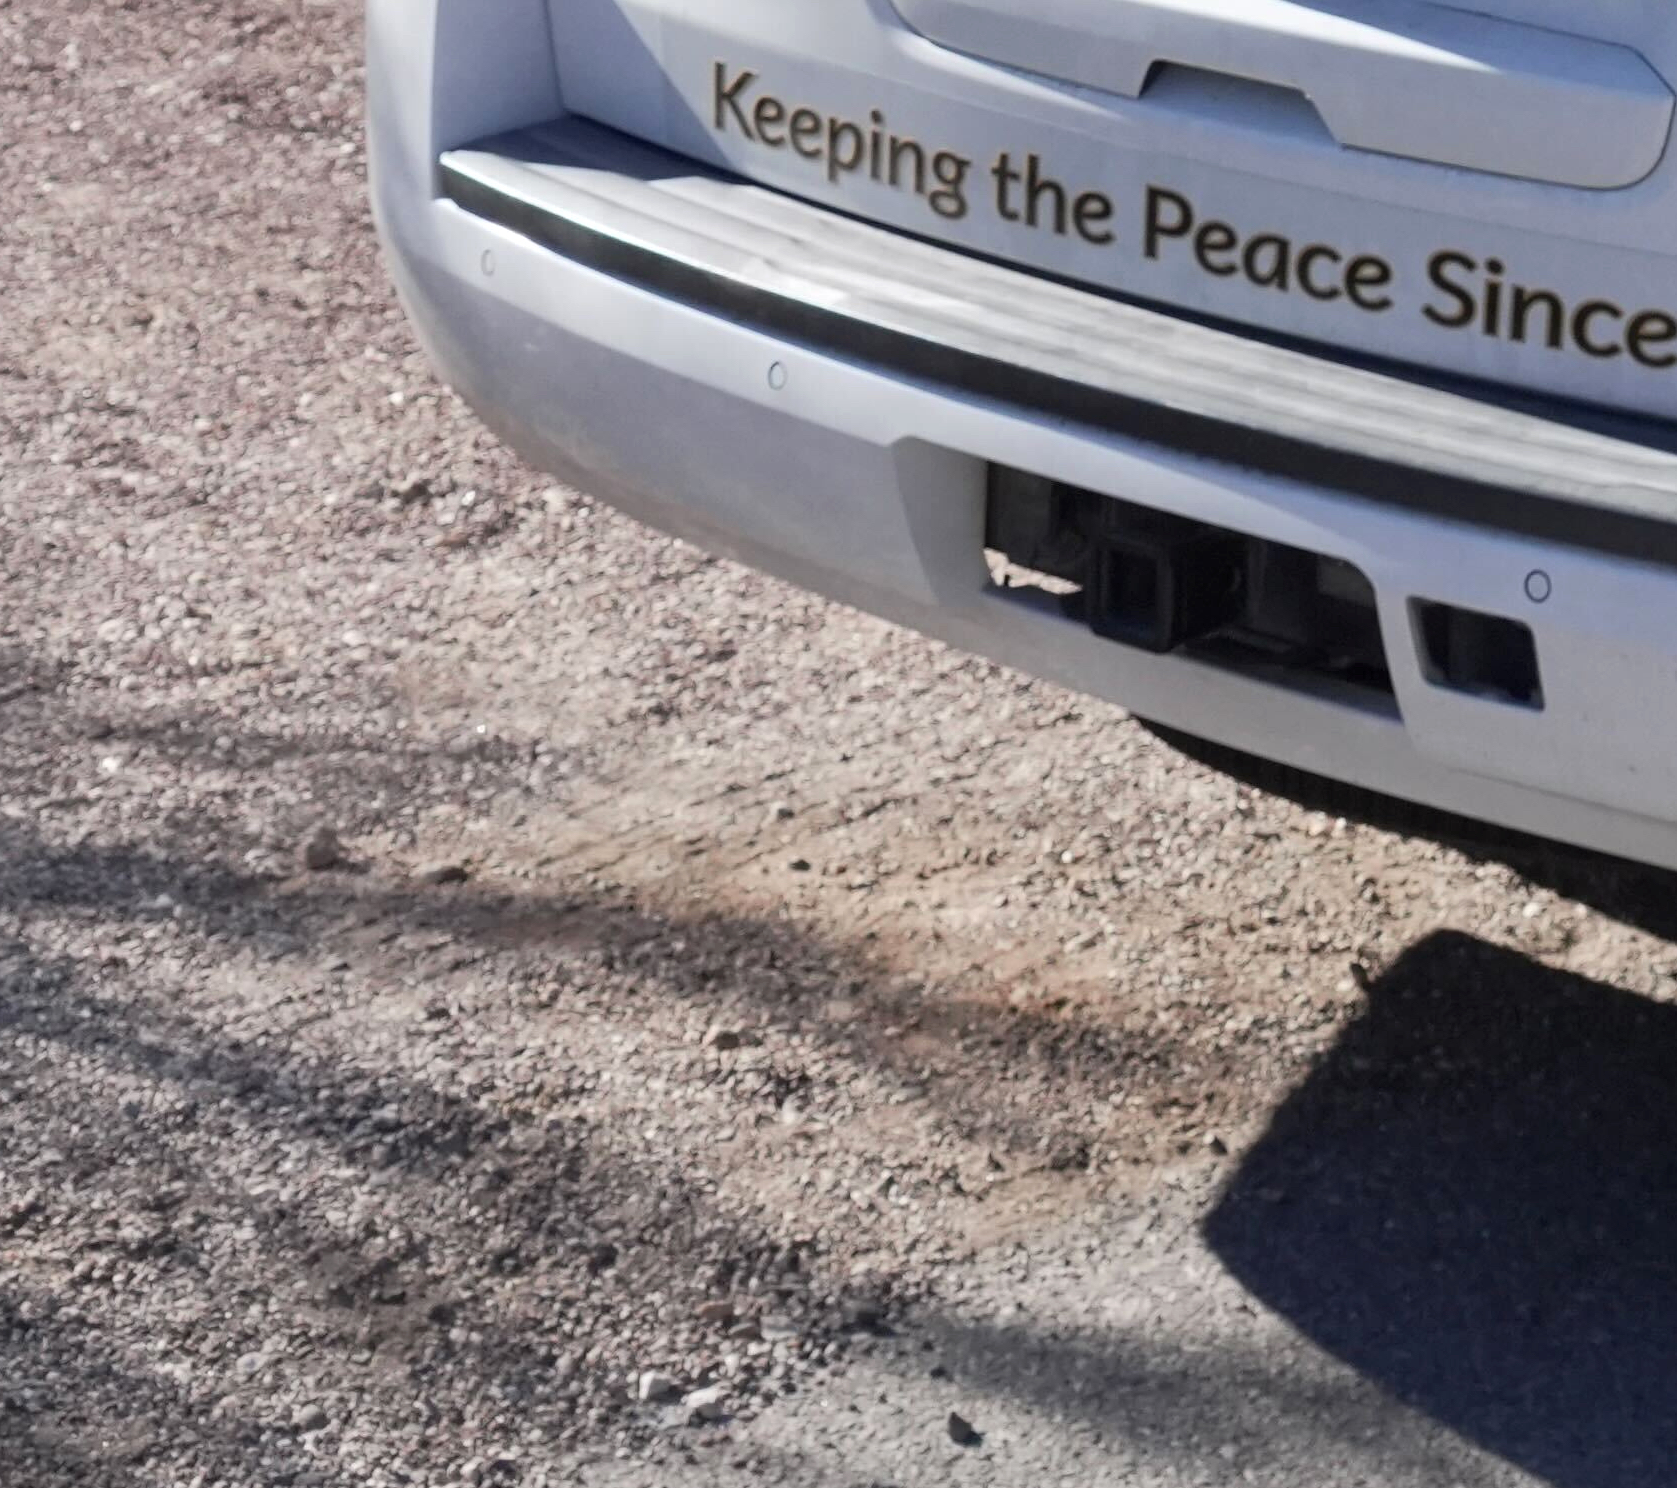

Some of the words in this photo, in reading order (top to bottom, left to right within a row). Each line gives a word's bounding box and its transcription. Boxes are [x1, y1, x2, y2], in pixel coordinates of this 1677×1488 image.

[711, 60, 973, 221] Keeping
[990, 151, 1116, 247] the
[1142, 183, 1394, 311] Peace
